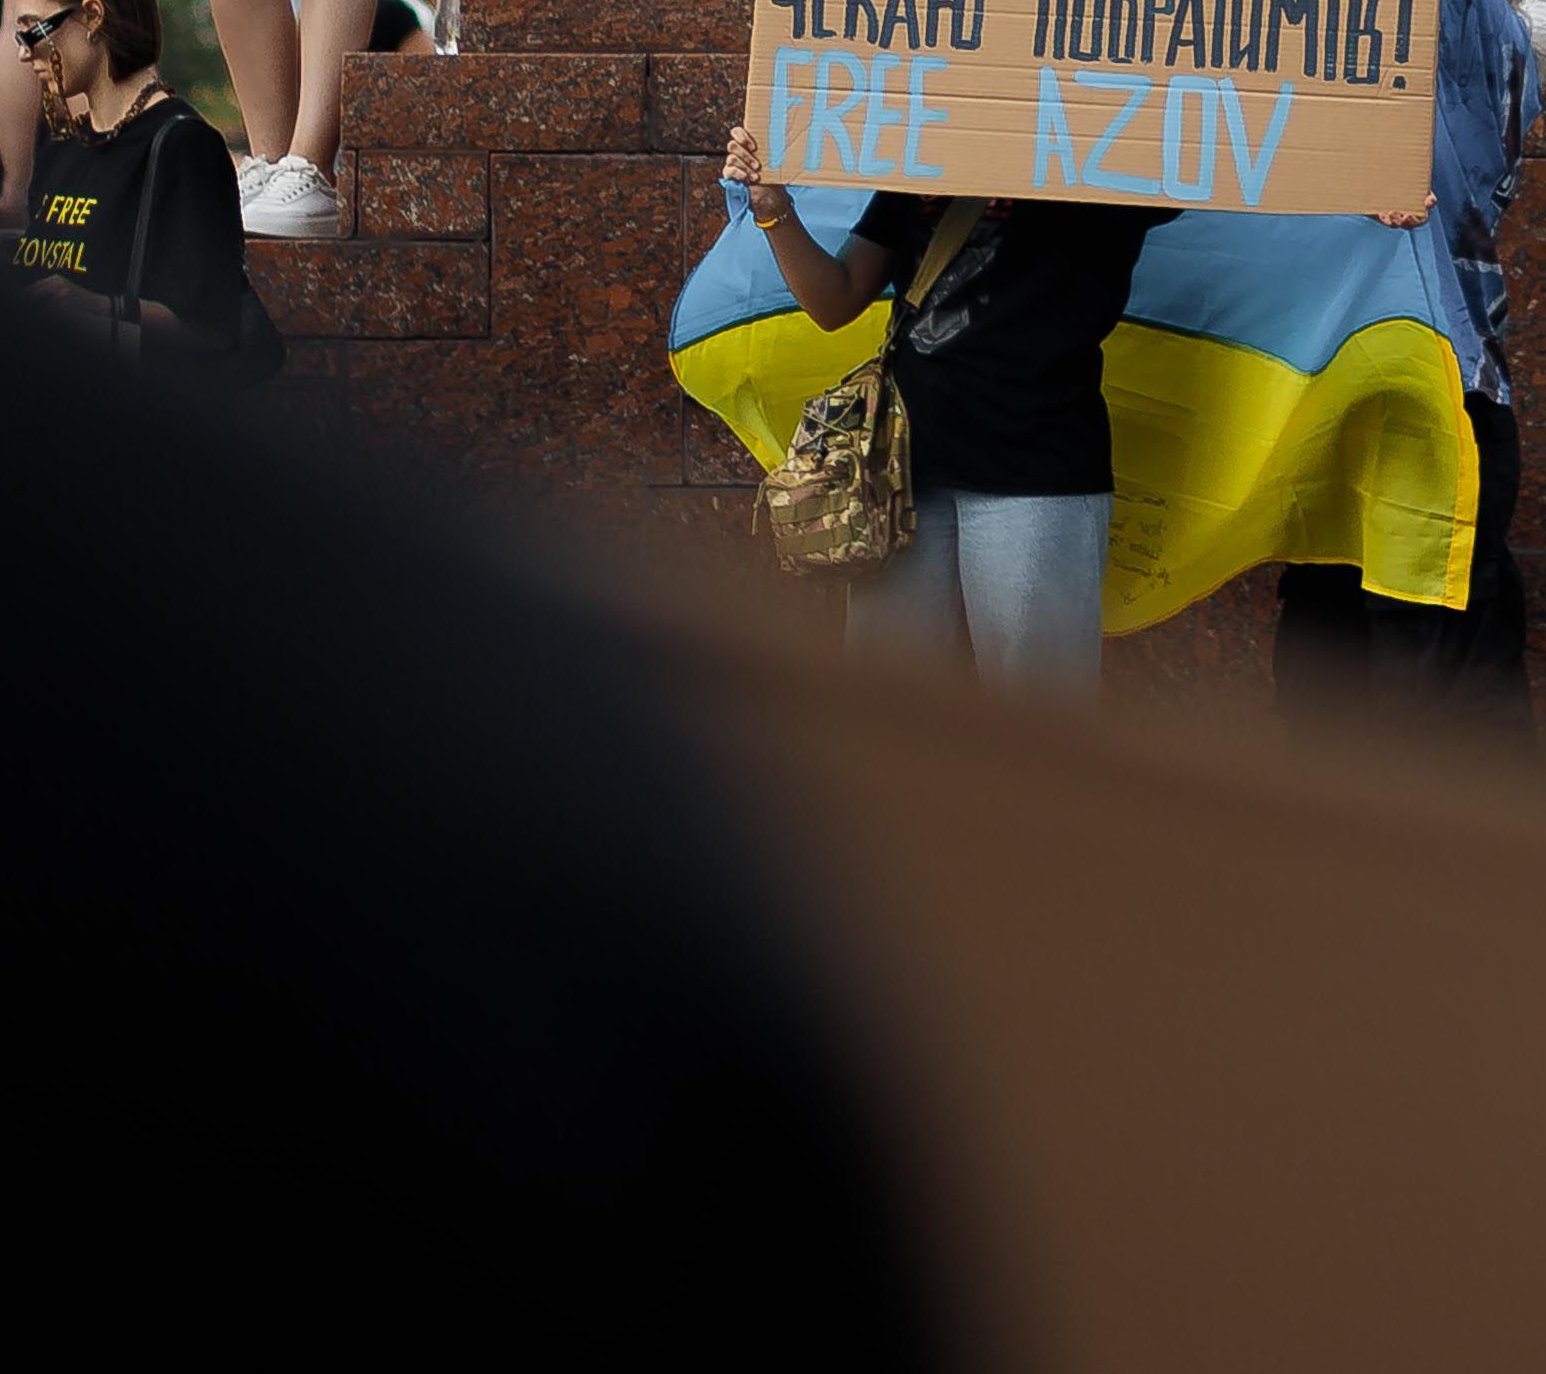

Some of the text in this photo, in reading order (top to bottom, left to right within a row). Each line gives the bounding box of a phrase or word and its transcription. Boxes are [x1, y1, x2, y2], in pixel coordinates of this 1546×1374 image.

[767, 46, 1293, 207] FREE AZOV
[47, 195, 98, 226] FREE
[11, 235, 88, 275] ZOVSTAL
